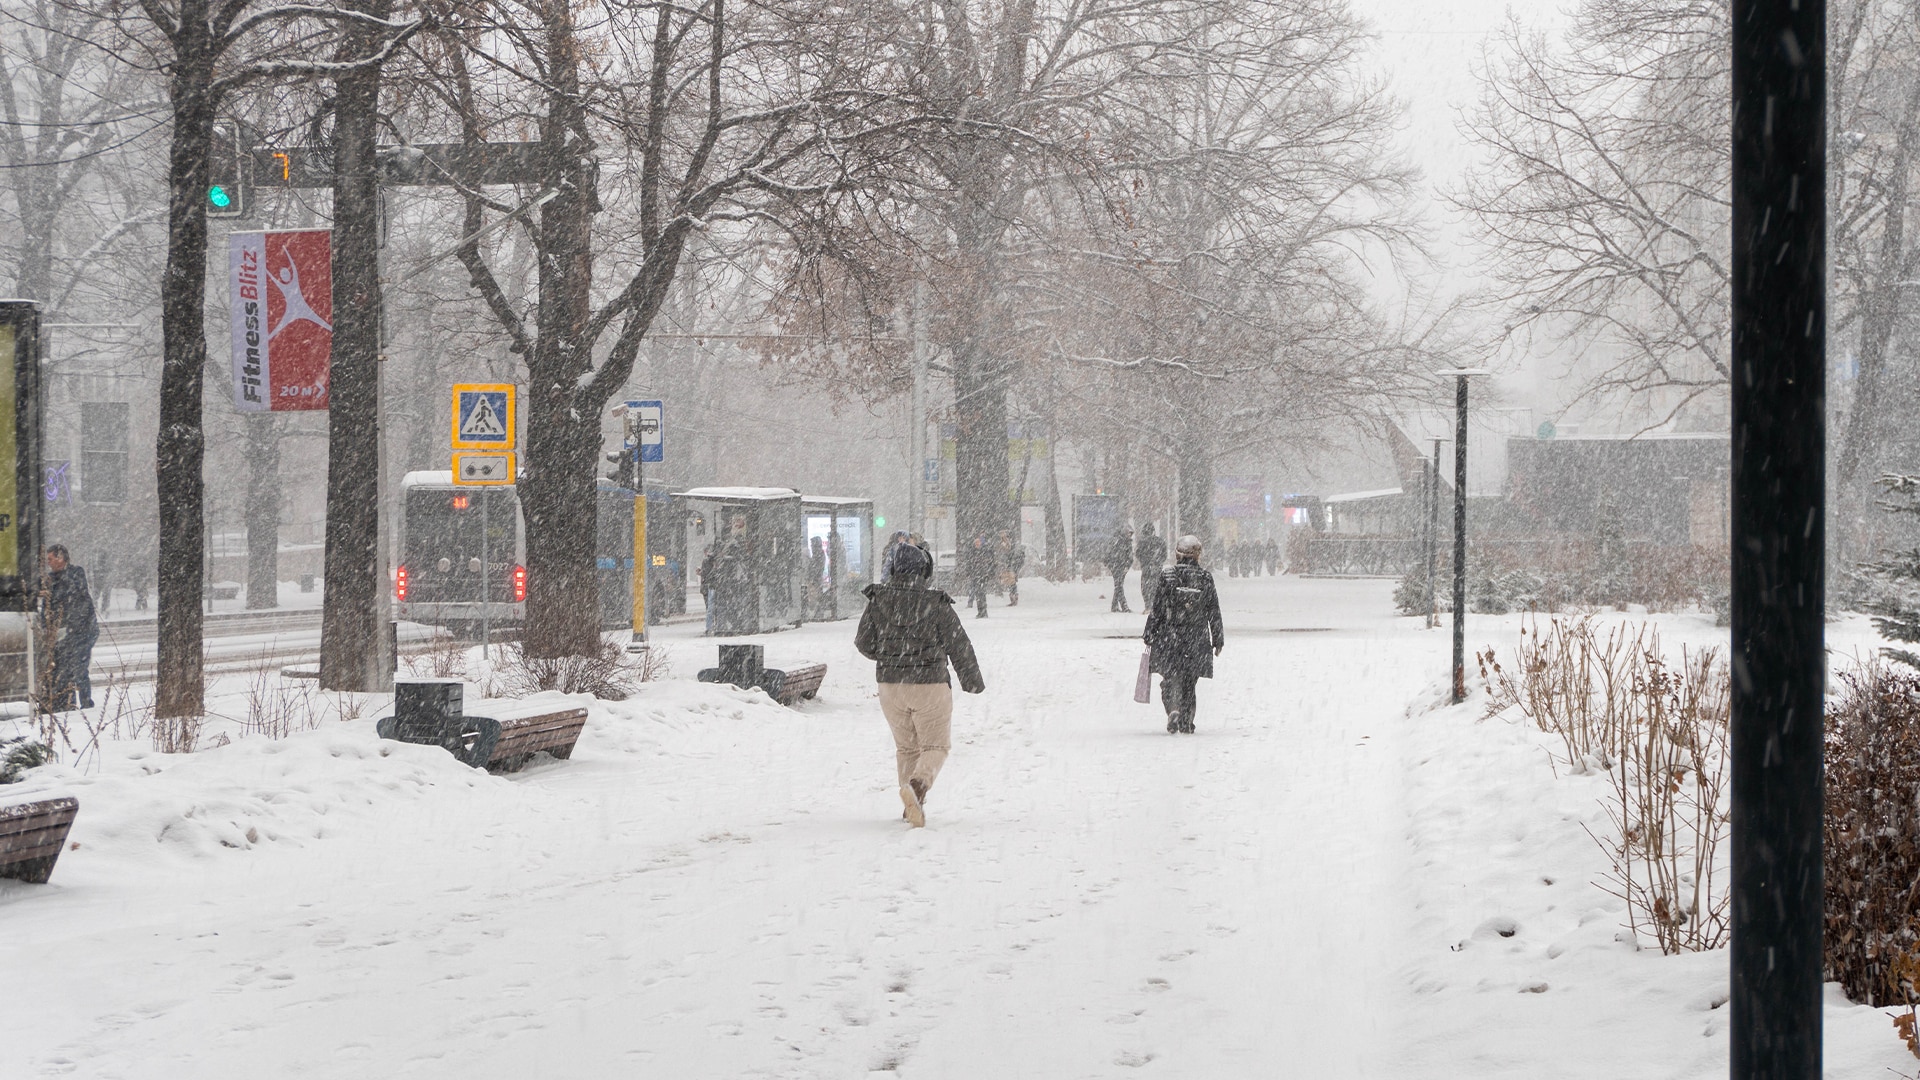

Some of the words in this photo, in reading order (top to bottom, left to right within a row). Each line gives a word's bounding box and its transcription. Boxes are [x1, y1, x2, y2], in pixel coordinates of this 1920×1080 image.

[272, 151, 289, 180] 7
[280, 386, 298, 397] 20
[487, 562, 509, 571] 7027
